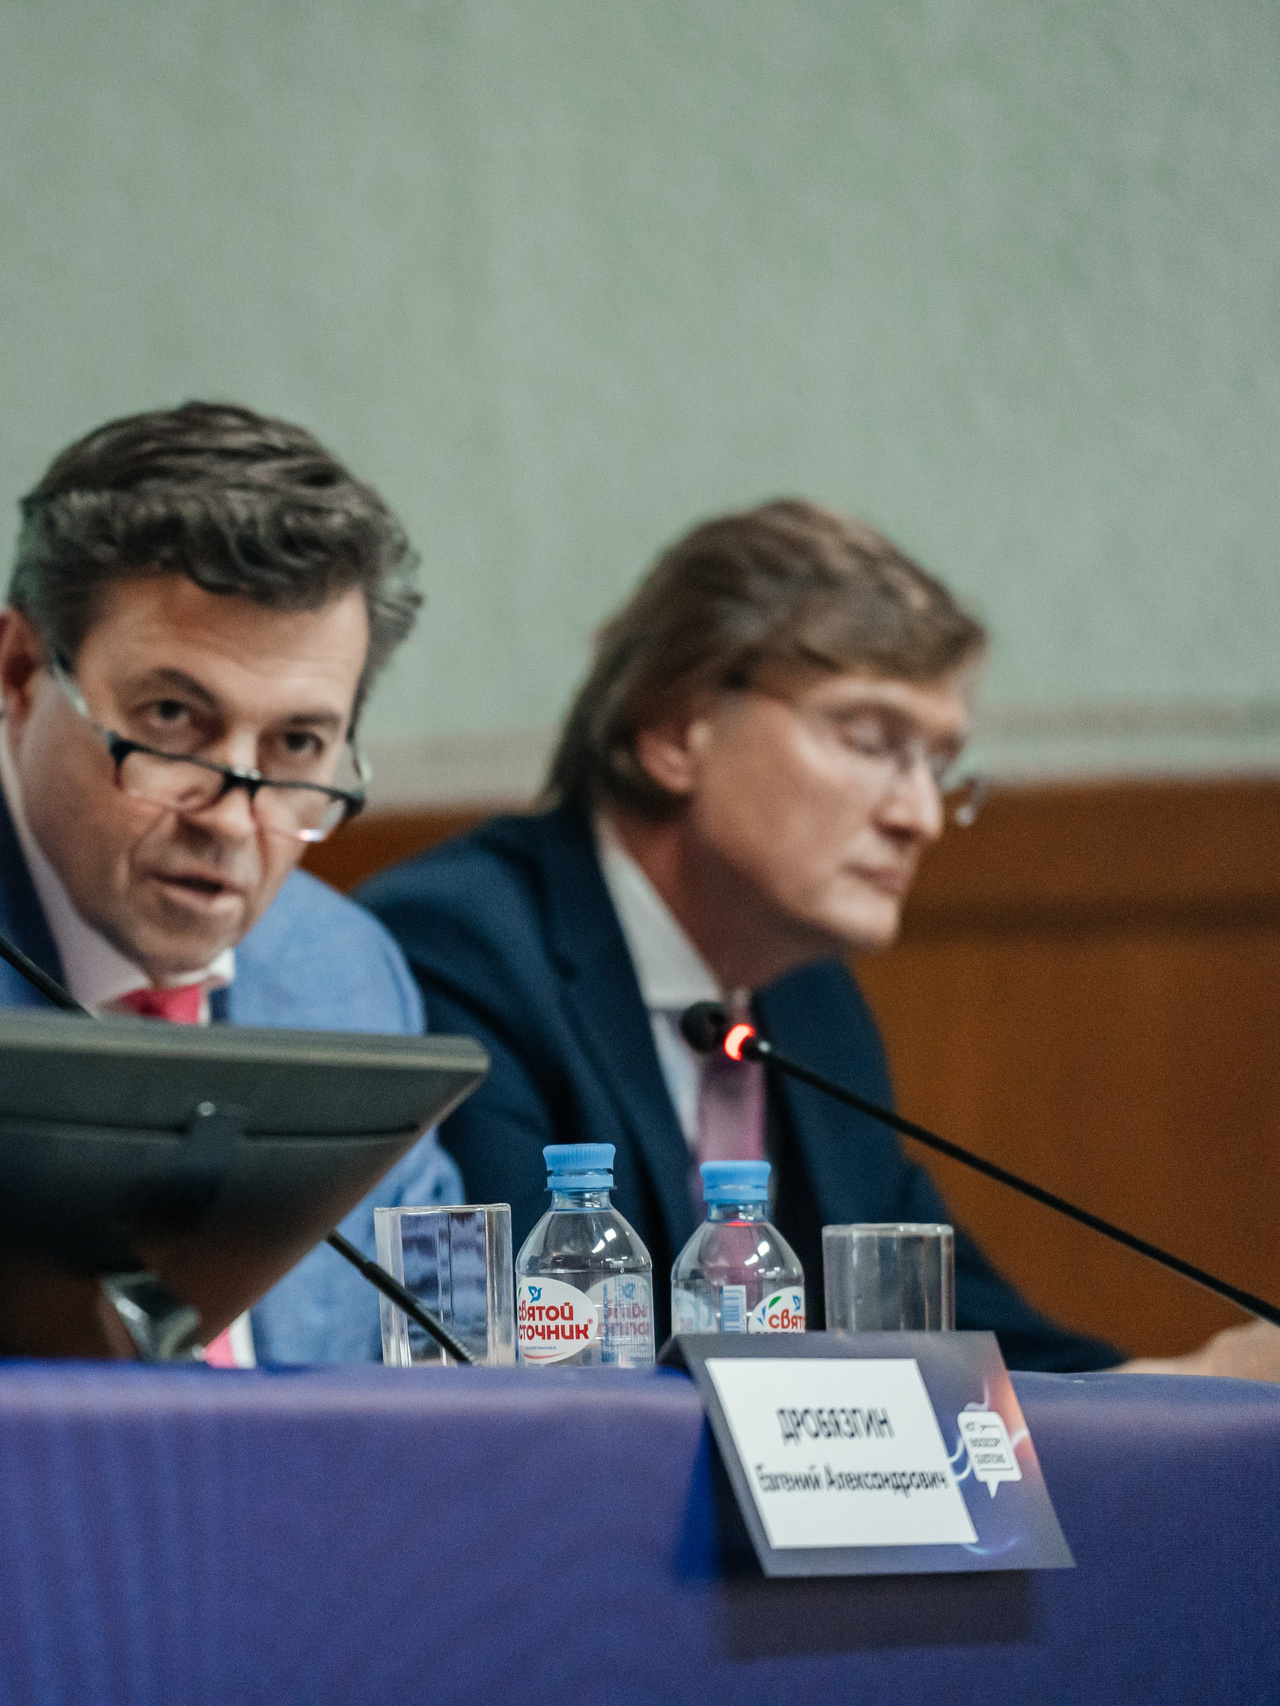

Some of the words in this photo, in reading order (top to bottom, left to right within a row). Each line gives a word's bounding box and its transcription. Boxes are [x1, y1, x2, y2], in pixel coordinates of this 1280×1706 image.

[519, 1324, 589, 1340] СТОЧНИК
[777, 1407, 895, 1445] ДРОБЯЗГИН
[755, 1463, 821, 1491] Евгений
[824, 1463, 949, 1498] Александрович
